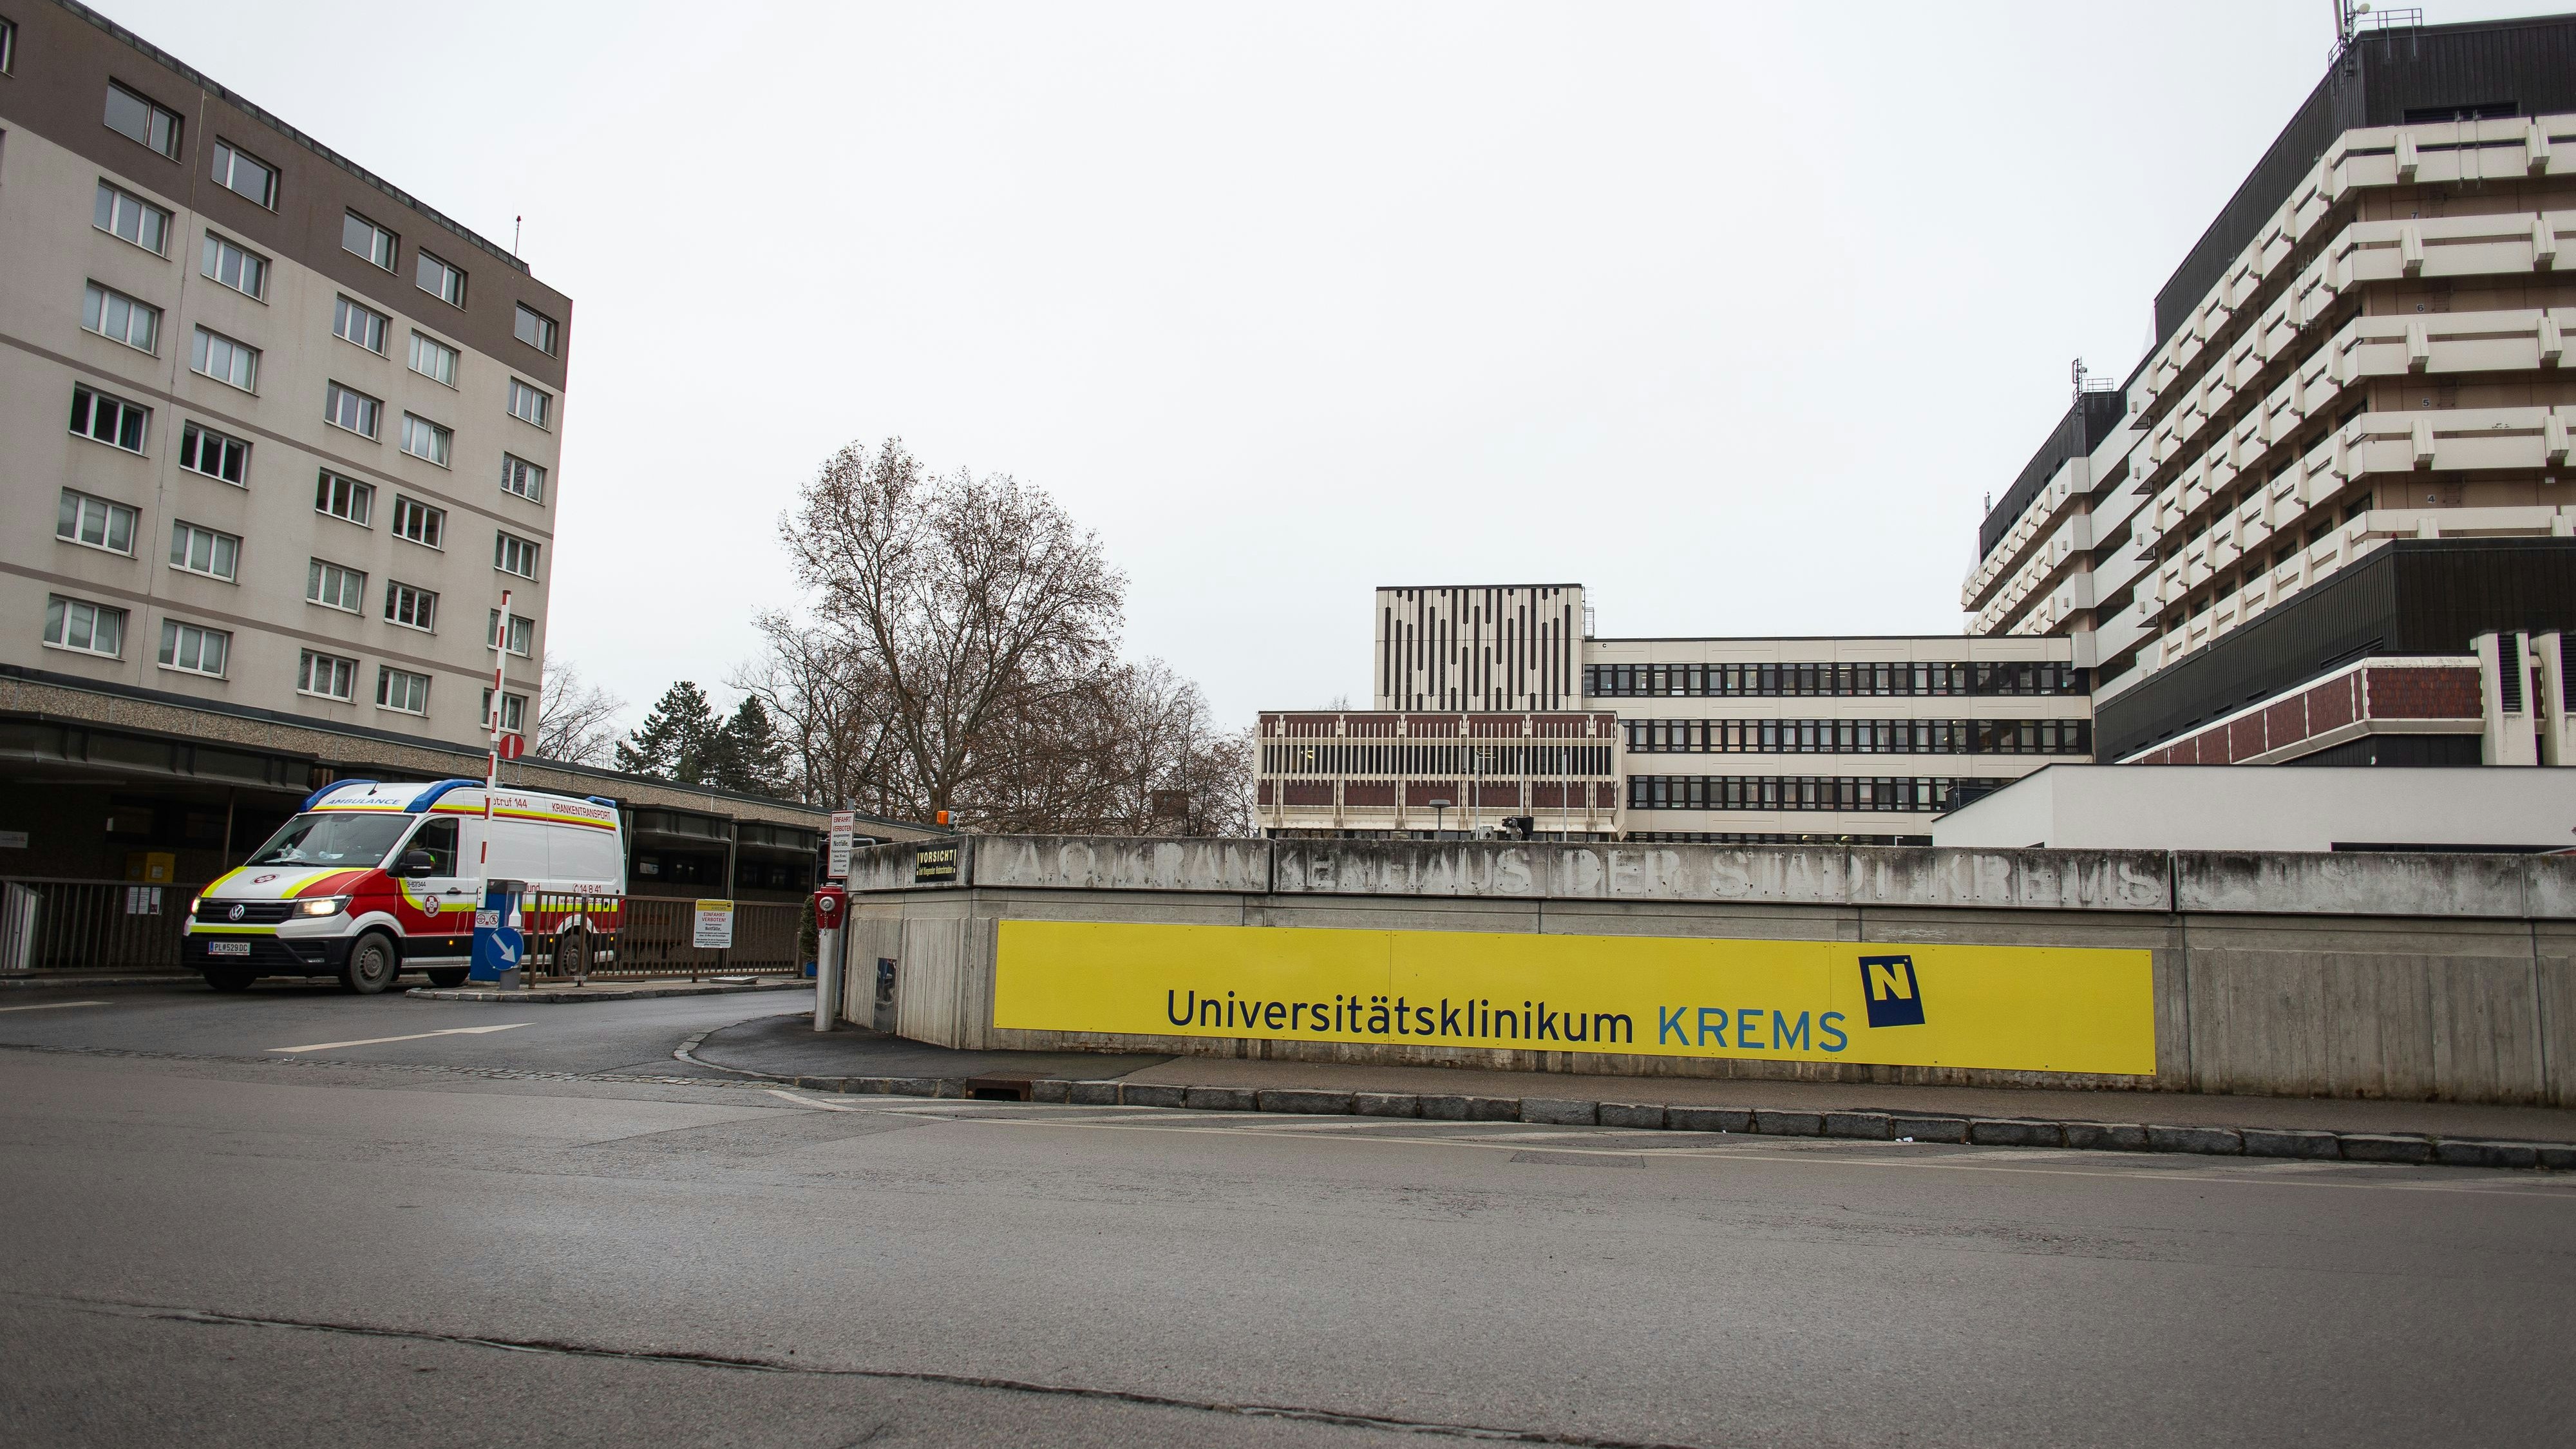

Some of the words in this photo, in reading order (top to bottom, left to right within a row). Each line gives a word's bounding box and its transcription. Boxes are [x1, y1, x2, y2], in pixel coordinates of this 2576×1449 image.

[515, 798, 527, 808] 144
[552, 802, 611, 820] KRANKENTRANSPORT
[580, 885, 587, 893] 14
[589, 885, 593, 893] 8
[595, 885, 601, 893] 41
[1168, 990, 1633, 1043] Universitätsklinikum
[1660, 1007, 1848, 1052] KREMS
